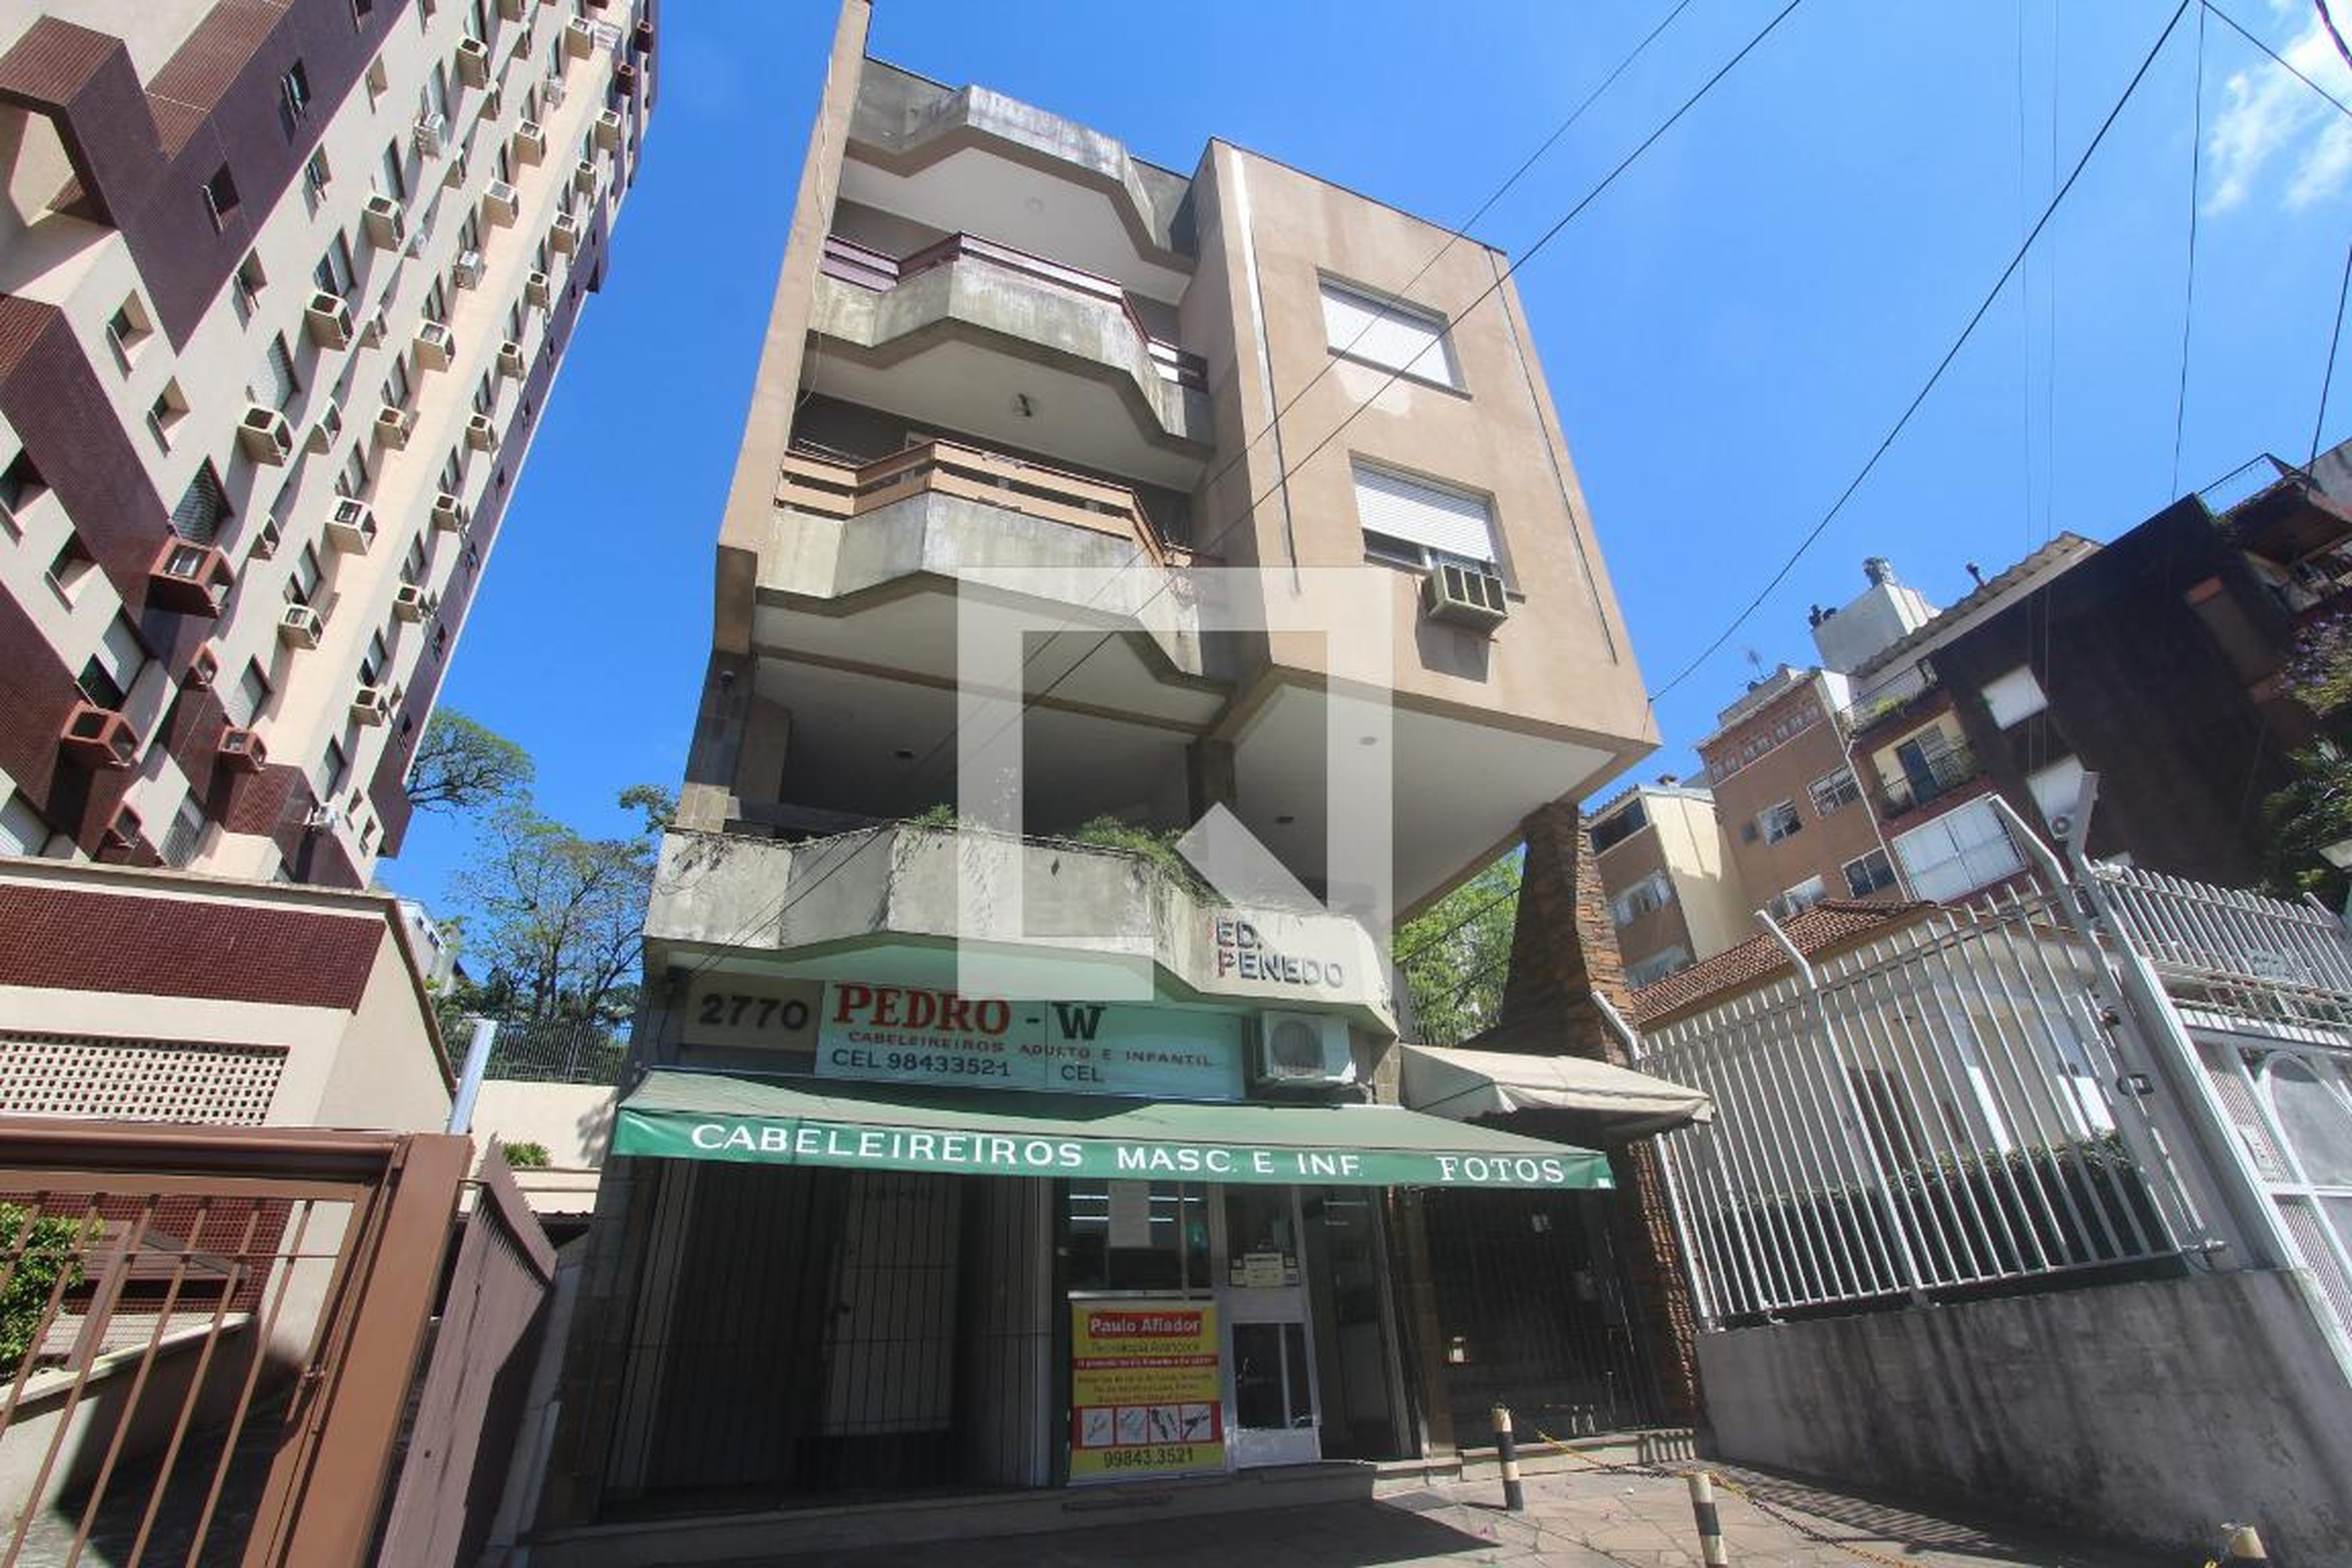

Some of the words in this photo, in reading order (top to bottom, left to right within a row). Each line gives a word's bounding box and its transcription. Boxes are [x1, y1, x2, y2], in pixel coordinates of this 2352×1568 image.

[1216, 917, 1262, 950] ED.
[1217, 949, 1343, 989] PENEDO
[698, 993, 809, 1030] 2770
[833, 982, 1011, 1036] PEDRO
[1052, 1001, 1107, 1040] W
[832, 1049, 882, 1069] CEL
[887, 1052, 1012, 1077] 98433521
[1061, 1064, 1104, 1083] CEL
[849, 1031, 1005, 1052] CABELEIREIROS
[1102, 1049, 1112, 1060] E
[1126, 1050, 1211, 1067] INFANTIL
[691, 1123, 1083, 1166] CABELEIREIROS
[1253, 1152, 1275, 1173] E
[1436, 1156, 1566, 1183] FOTOS
[1090, 1318, 1136, 1333] Paulo
[1140, 1317, 1199, 1332] Afiador
